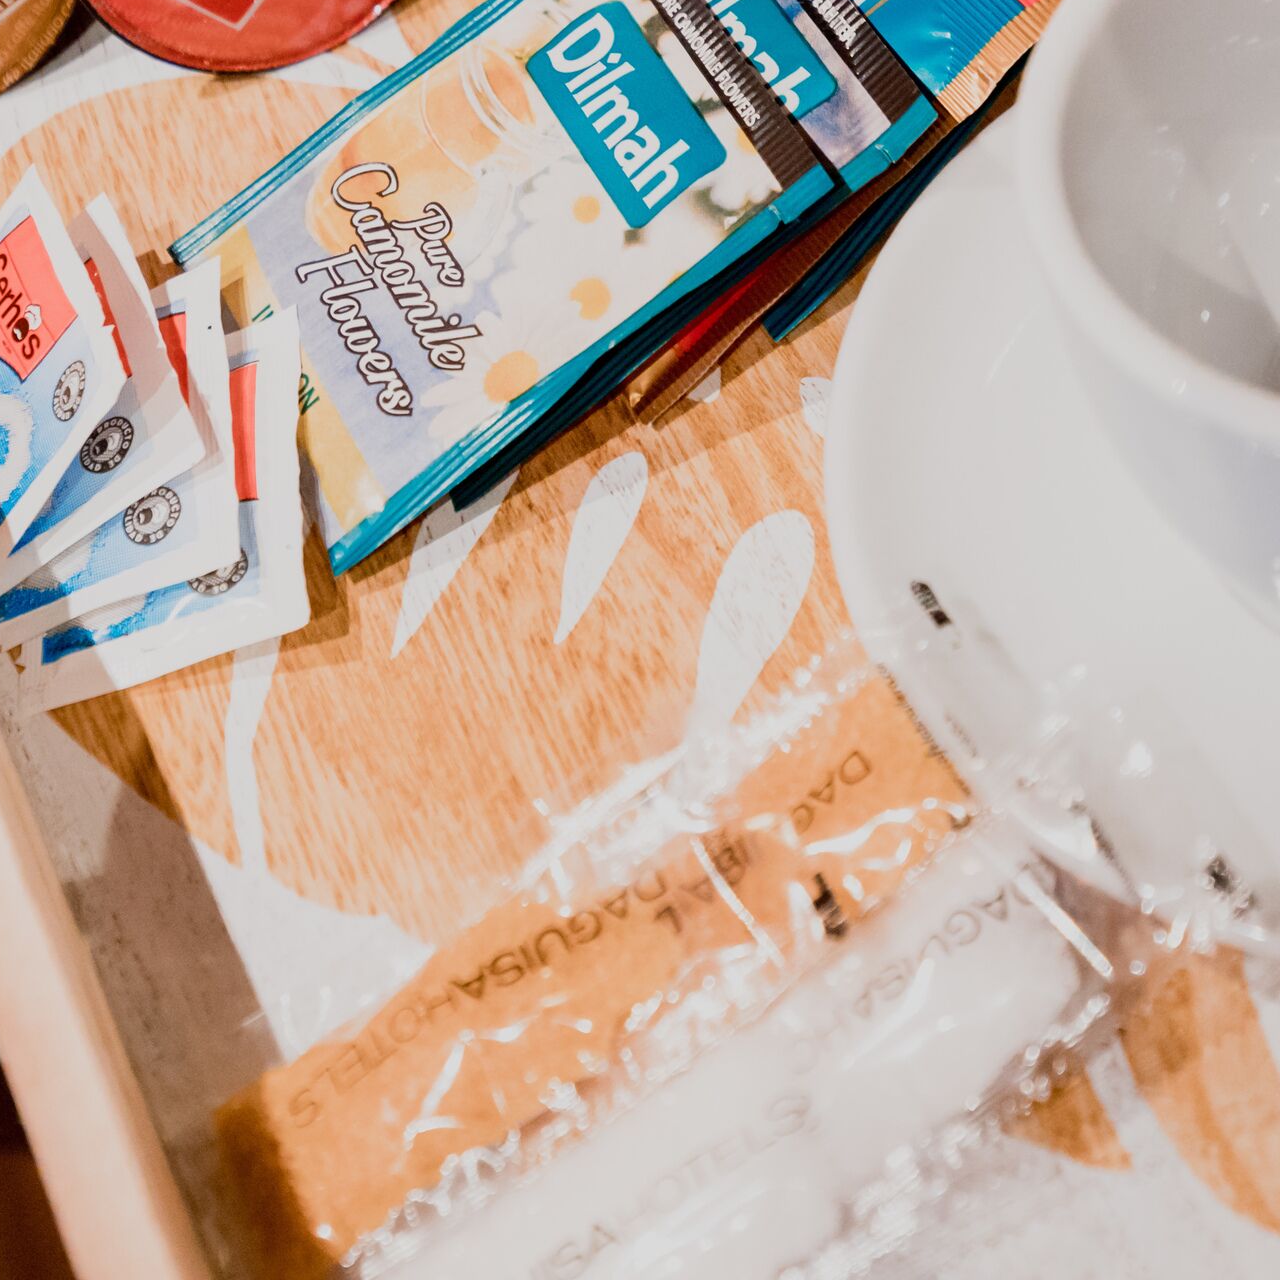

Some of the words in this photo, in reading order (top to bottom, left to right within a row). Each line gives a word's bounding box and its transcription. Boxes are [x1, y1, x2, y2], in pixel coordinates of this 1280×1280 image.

[546, 11, 691, 211] Dilmah
[670, 10, 726, 78] CAMOMILE
[712, 69, 762, 128] FLOWERS
[295, 244, 413, 417] Flowers
[331, 161, 484, 371] Camomile
[390, 200, 465, 288] Pure
